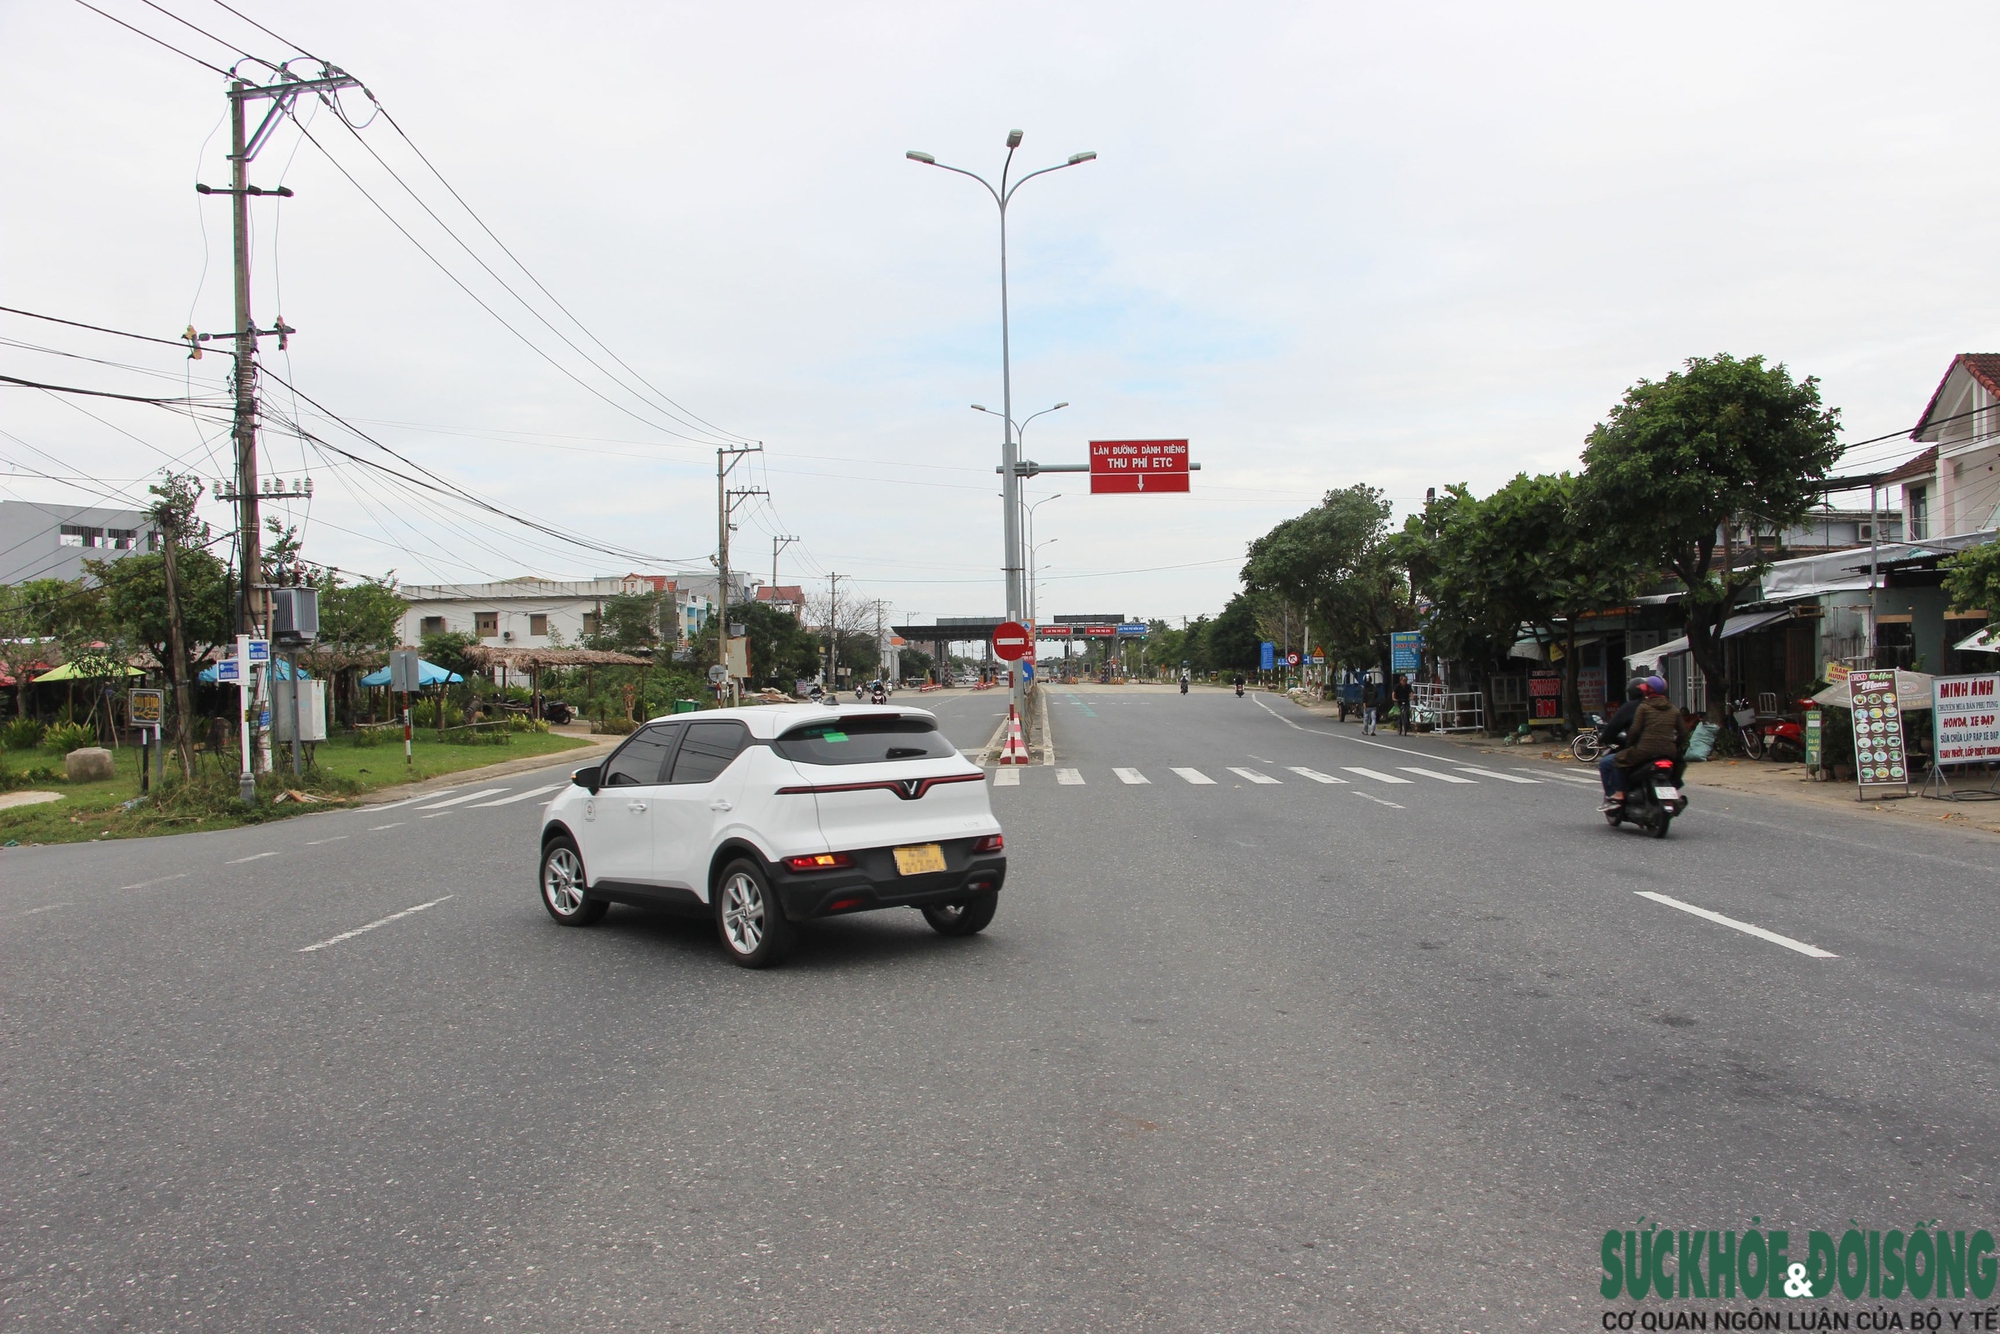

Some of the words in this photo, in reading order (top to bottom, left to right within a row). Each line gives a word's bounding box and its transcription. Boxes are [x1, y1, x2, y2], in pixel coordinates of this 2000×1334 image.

[1094, 445, 1108, 455] LÀN
[1112, 444, 1138, 454] ĐƯỜNG
[1142, 444, 1160, 454] DÀNH
[1164, 444, 1186, 453] RIÊNG
[1107, 458, 1127, 468] THU
[1132, 456, 1147, 468] PHÍ
[1152, 458, 1173, 467] ETC
[1941, 682, 1968, 698] MINH
[1971, 678, 1994, 696] ÁNH
[1970, 716, 1979, 726] XE
[1980, 715, 1995, 728] ĐẠP
